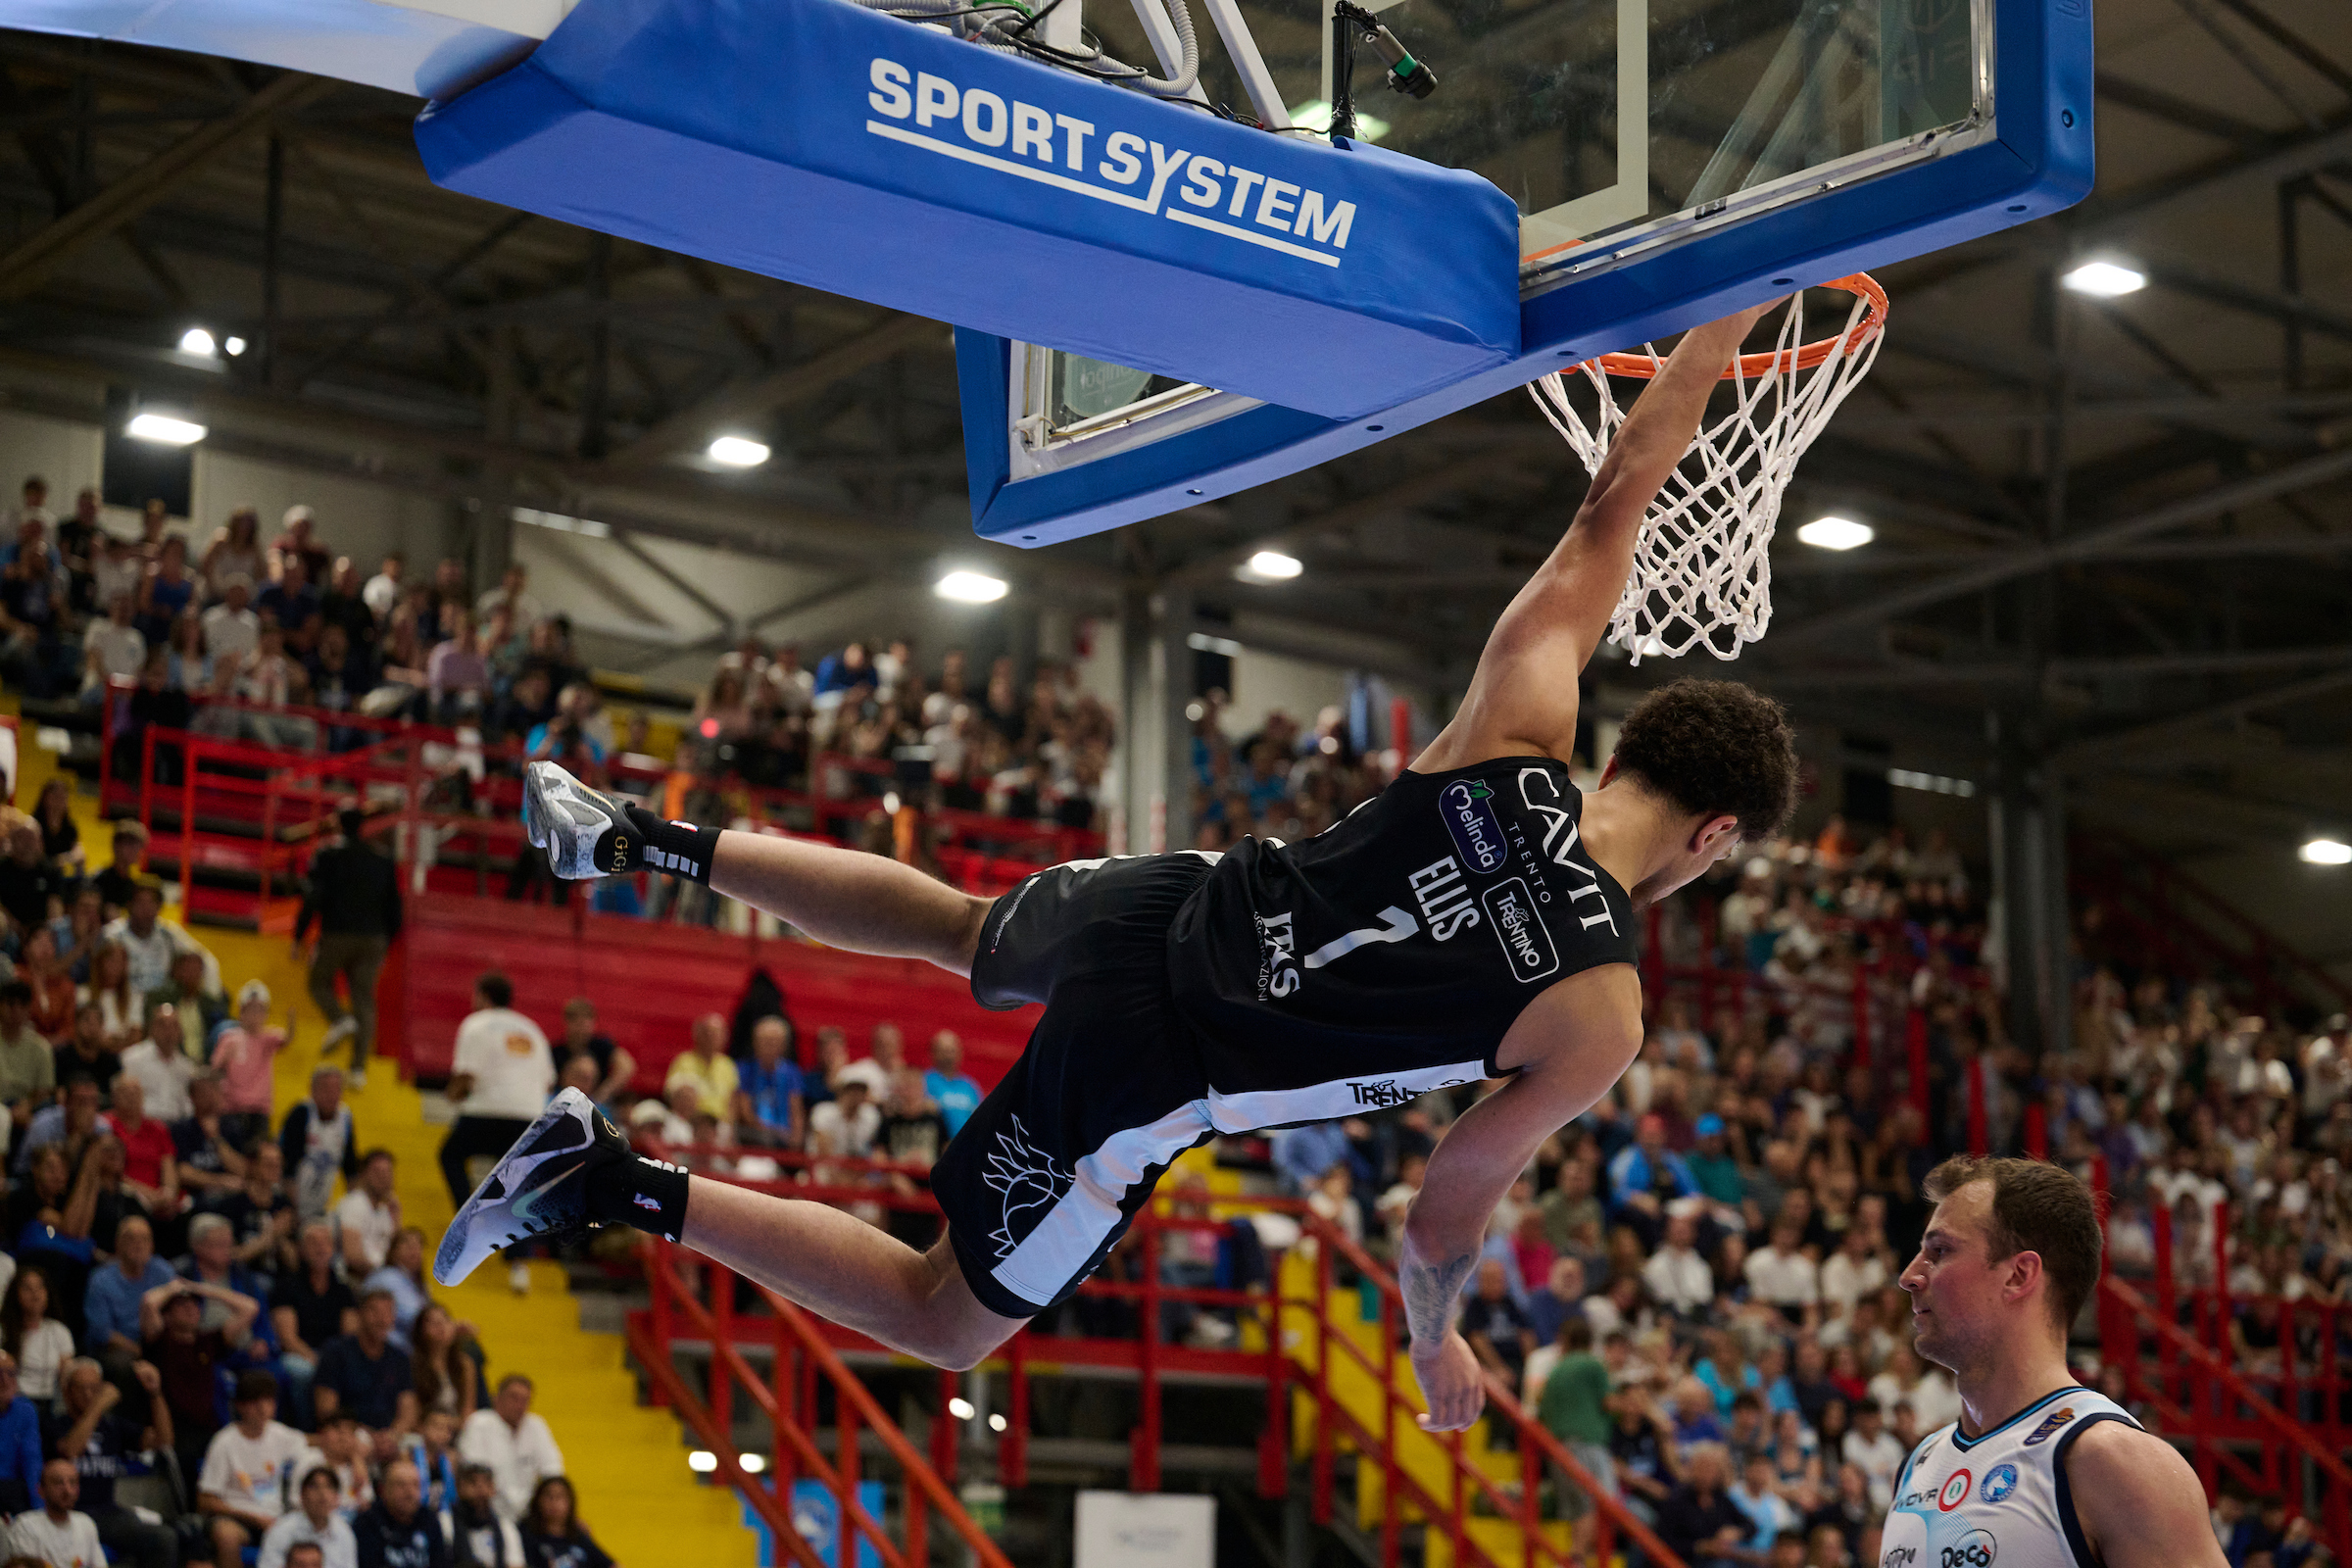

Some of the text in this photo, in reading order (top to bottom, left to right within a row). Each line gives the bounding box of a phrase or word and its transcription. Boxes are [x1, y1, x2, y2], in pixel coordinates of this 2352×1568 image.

[867, 57, 1357, 250] SPORT SYSTEM
[1449, 784, 1496, 868] Melinda
[1508, 821, 1551, 904] TRENTO
[1518, 767, 1620, 938] CAVIT
[1407, 855, 1480, 943] ELLIS
[1496, 891, 1541, 967] TRENTINO
